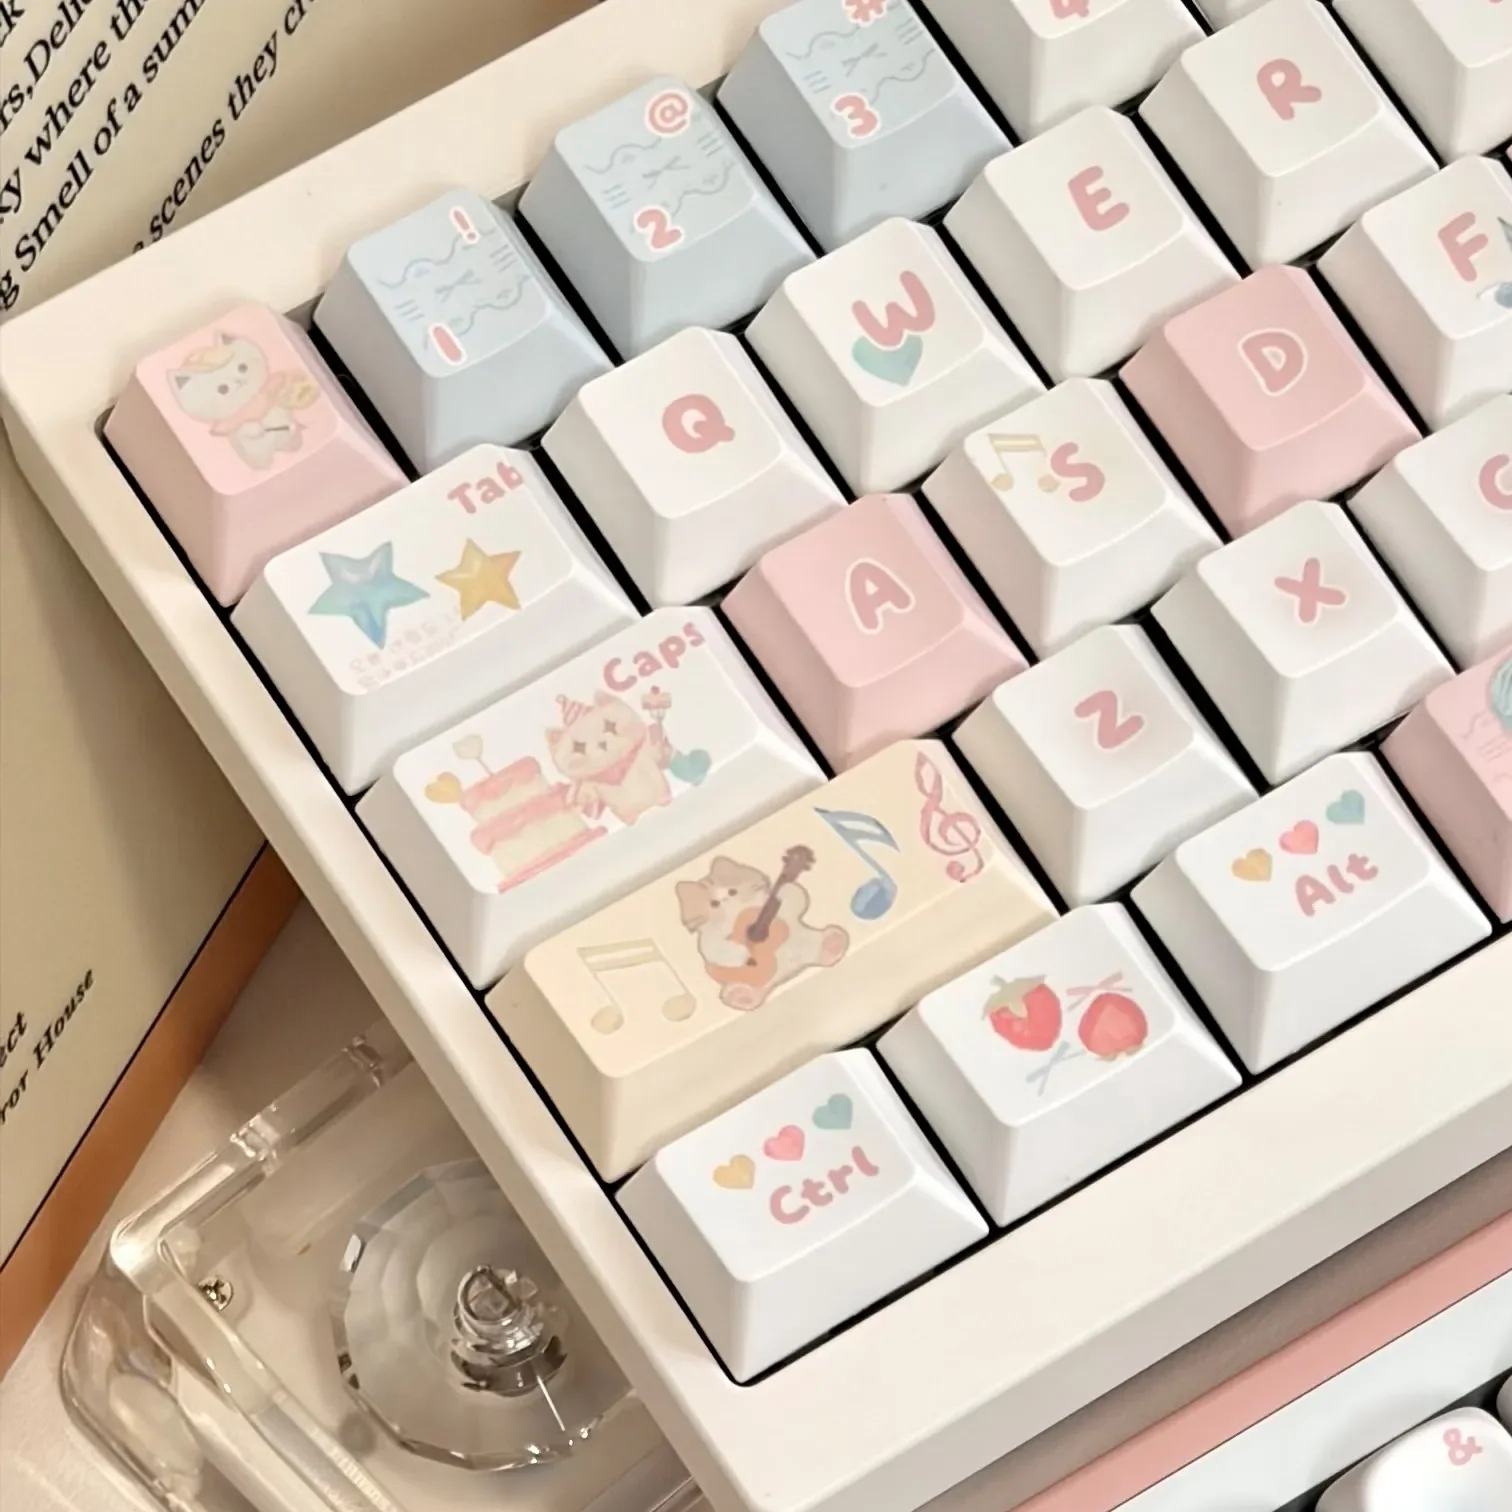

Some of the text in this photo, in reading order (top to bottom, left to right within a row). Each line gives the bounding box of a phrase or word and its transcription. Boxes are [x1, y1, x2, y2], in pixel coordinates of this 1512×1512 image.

[0, 0, 25, 48] k
[25, 40, 111, 166] where
[110, 0, 150, 41] th
[648, 92, 688, 135] @
[1256, 58, 1322, 121] R
[149, 118, 226, 243] scenes
[227, 29, 278, 122] they
[834, 96, 877, 136] 3
[14, 149, 93, 272] Smell
[93, 97, 123, 156] of
[123, 82, 143, 113] a
[1069, 165, 1130, 231] E
[455, 209, 478, 242] !
[636, 209, 683, 249] 2
[1437, 212, 1488, 281] F
[852, 271, 935, 349] W
[1239, 329, 1306, 395] D
[662, 394, 735, 453] Q
[448, 462, 524, 513] Tab
[1051, 442, 1105, 501] S
[847, 559, 913, 634] A
[1274, 558, 1346, 623] X
[604, 622, 705, 692] Caps
[1074, 690, 1144, 749] Z
[1294, 853, 1378, 916] Alt
[33, 969, 94, 1069] House
[769, 1146, 879, 1224] Ctrl
[1443, 1427, 1483, 1466] &
